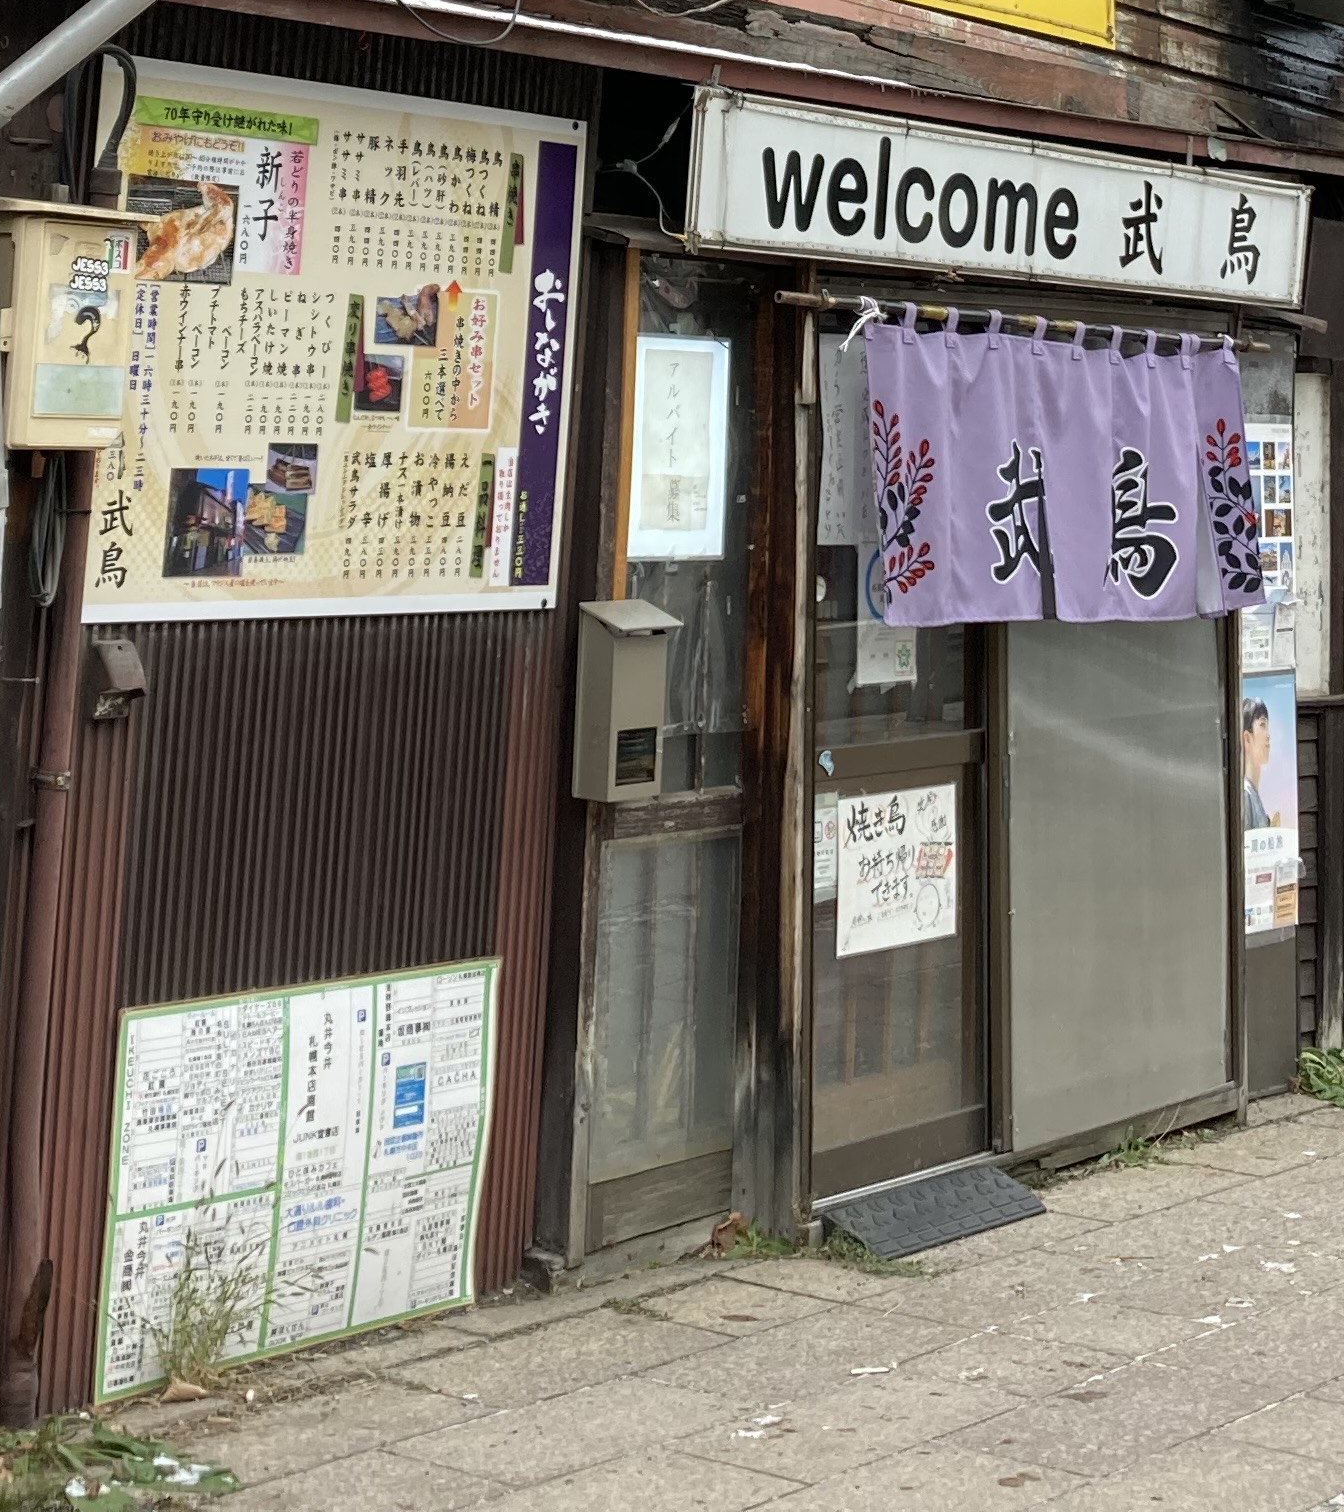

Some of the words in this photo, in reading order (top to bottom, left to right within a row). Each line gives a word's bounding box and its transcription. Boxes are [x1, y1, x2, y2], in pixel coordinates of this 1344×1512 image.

[252, 146, 282, 242] 新子
[338, 130, 353, 200] ササミ串
[351, 132, 365, 201] ササミ串
[379, 136, 394, 206] ネック
[393, 138, 409, 208] 手羽先
[448, 145, 464, 214] 鳥かわ
[461, 147, 477, 216] 梅つくね
[475, 148, 490, 216] 鳥つくね
[762, 136, 1079, 260] welcome
[282, 150, 305, 270] 若どりの半身焼き
[190, 324, 203, 369] ベーコン
[220, 325, 232, 370] ベーコン
[235, 287, 249, 354] もちチーズ
[262, 289, 278, 376] しいたけ焼
[292, 292, 307, 377] ねぎ串
[306, 292, 321, 377] シシトウ串
[467, 297, 487, 409] お好み串セット
[528, 268, 565, 435] おしながき
[129, 351, 140, 390] 日曜日
[449, 316, 466, 422] 串焼きの中から
[346, 451, 362, 530] 武鳥サラダ
[425, 453, 440, 524] 冷やっこ
[456, 455, 470, 528] えだ豆
[985, 438, 1180, 600] 武鳥
[94, 489, 133, 589] 武鳥
[843, 795, 907, 849] 焼き鳥
[125, 1035, 136, 1111] IKEUCHI
[323, 1012, 333, 1070] 丸井今井
[121, 1122, 131, 1166] ZONE
